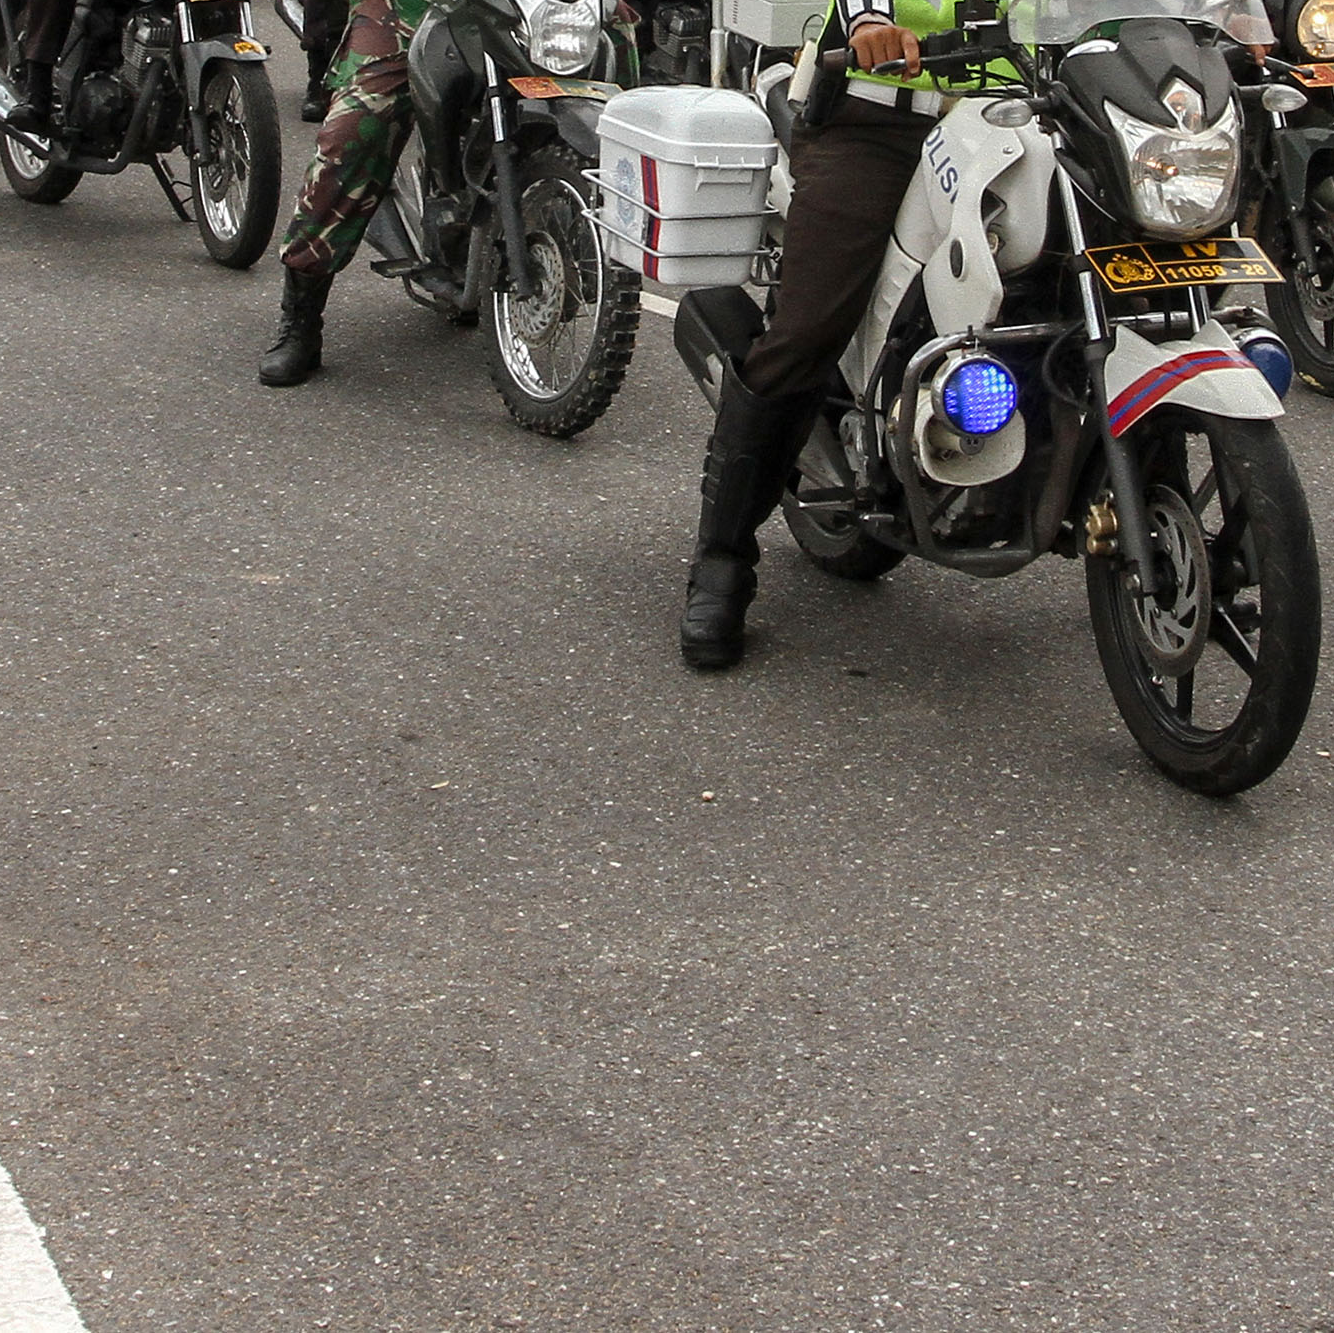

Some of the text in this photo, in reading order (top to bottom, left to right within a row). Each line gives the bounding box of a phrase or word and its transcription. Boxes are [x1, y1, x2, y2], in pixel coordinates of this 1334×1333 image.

[1180, 242, 1218, 258] IV
[1165, 264, 1226, 280] 11058
[1240, 263, 1268, 277] 28
